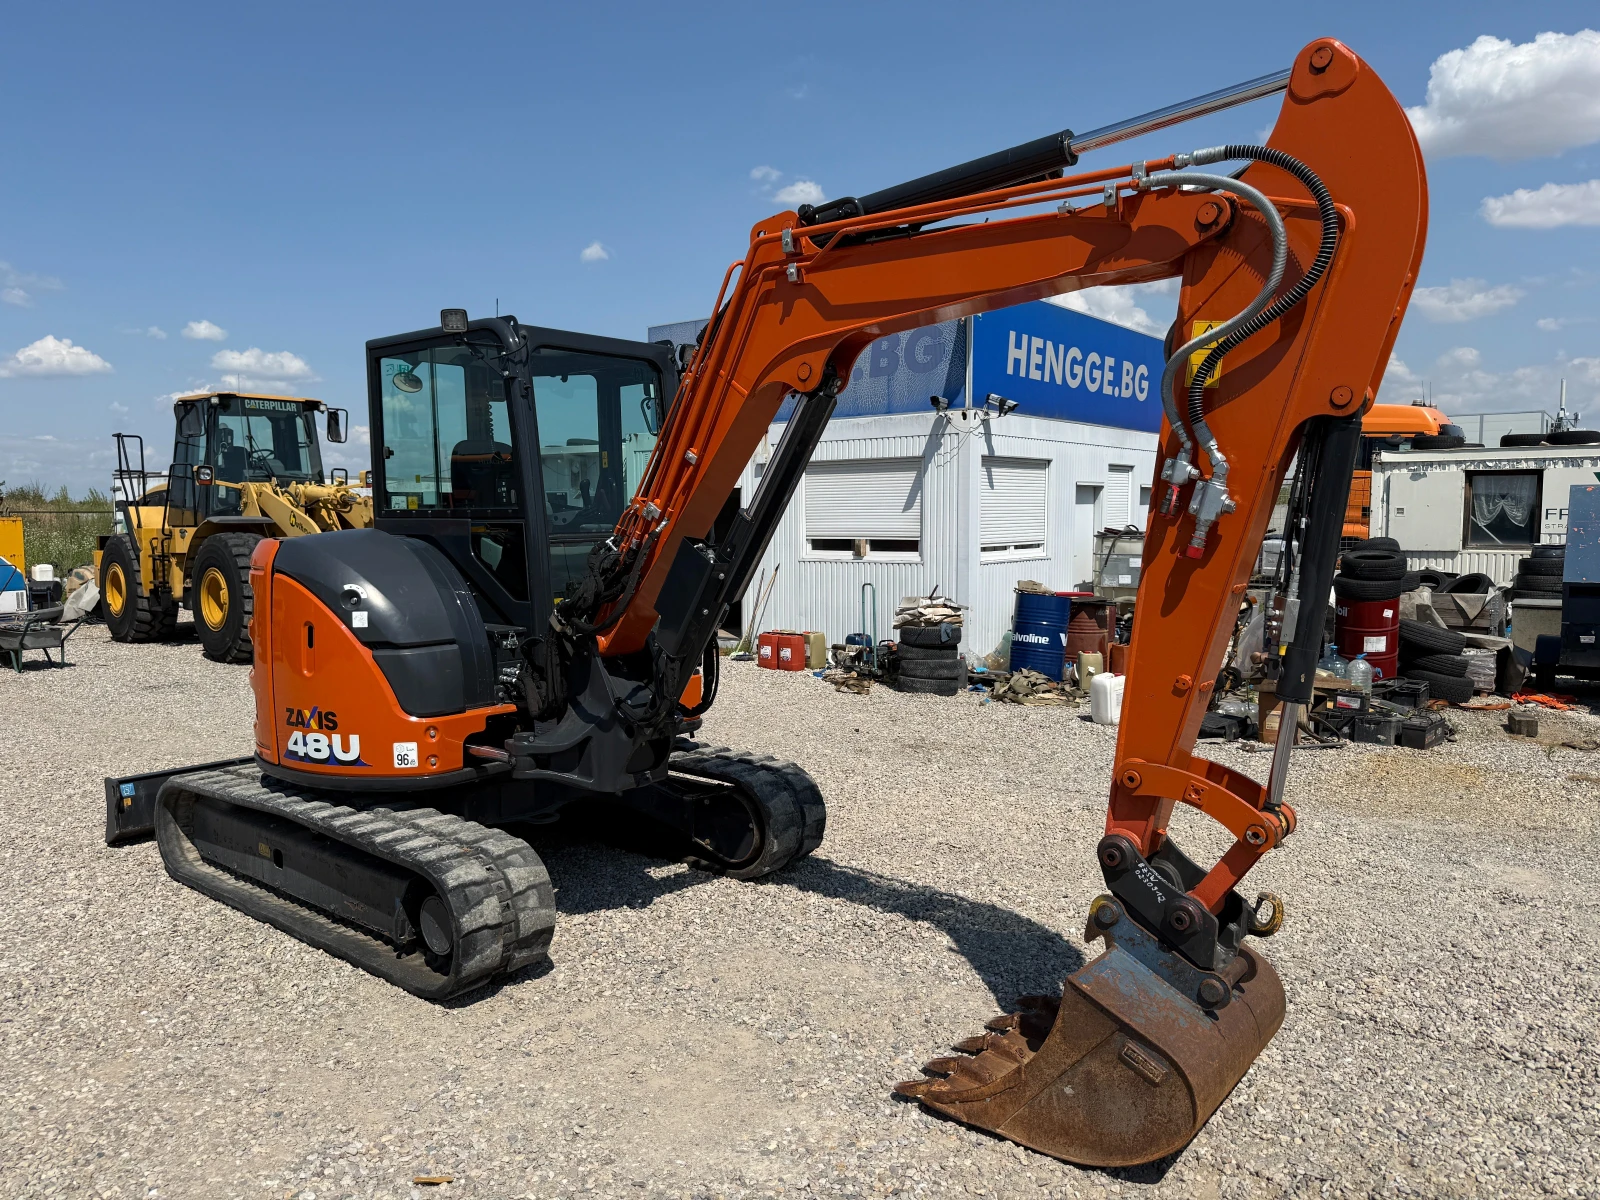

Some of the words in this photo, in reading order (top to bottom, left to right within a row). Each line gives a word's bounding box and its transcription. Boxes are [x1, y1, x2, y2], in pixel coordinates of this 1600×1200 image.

[1006, 330, 1149, 402] HENGGE.BG
[244, 399, 297, 412] CATERPILLAR
[285, 706, 338, 731] ZAXIS
[287, 730, 361, 767] 48U
[396, 753, 409, 766] 96
